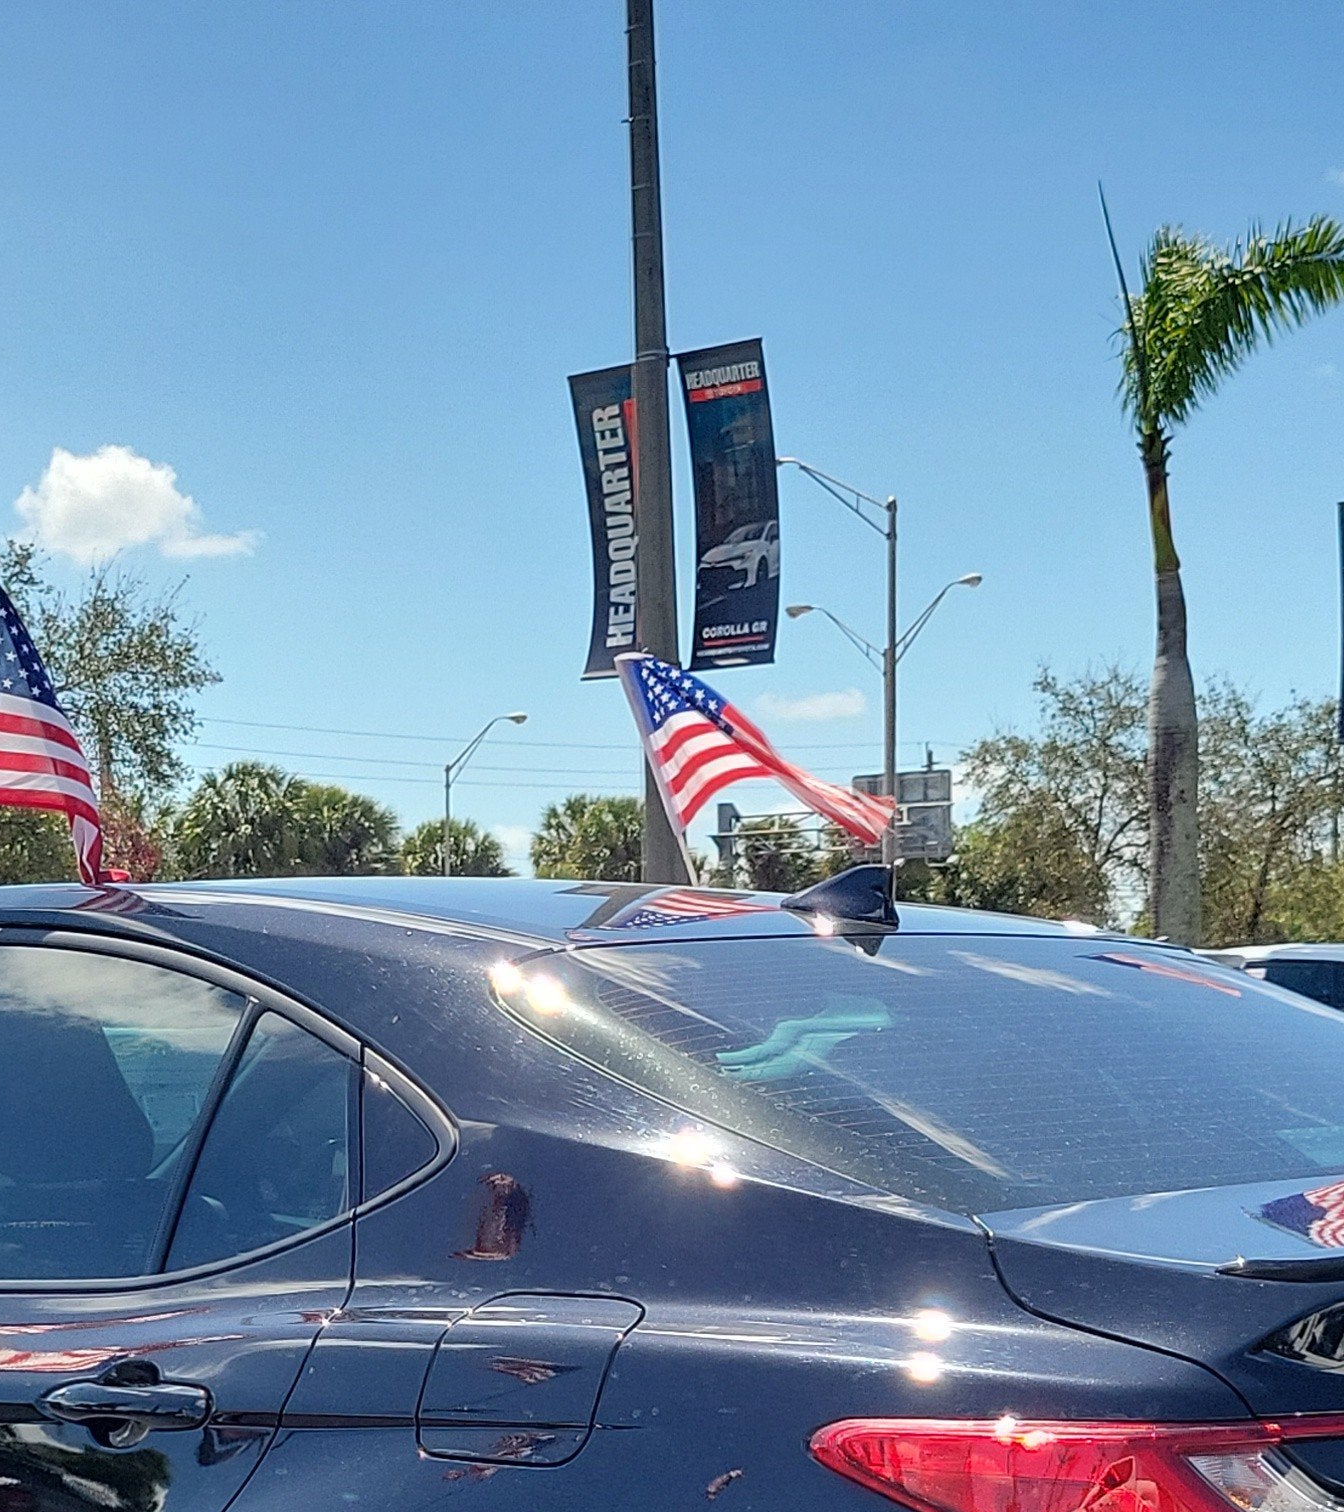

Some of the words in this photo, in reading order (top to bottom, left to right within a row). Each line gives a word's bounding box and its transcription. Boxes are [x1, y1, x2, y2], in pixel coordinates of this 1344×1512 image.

[685, 361, 760, 390] HEADQUARTER
[592, 403, 639, 648] HEADQUARTER
[702, 622, 750, 639] COROLLA
